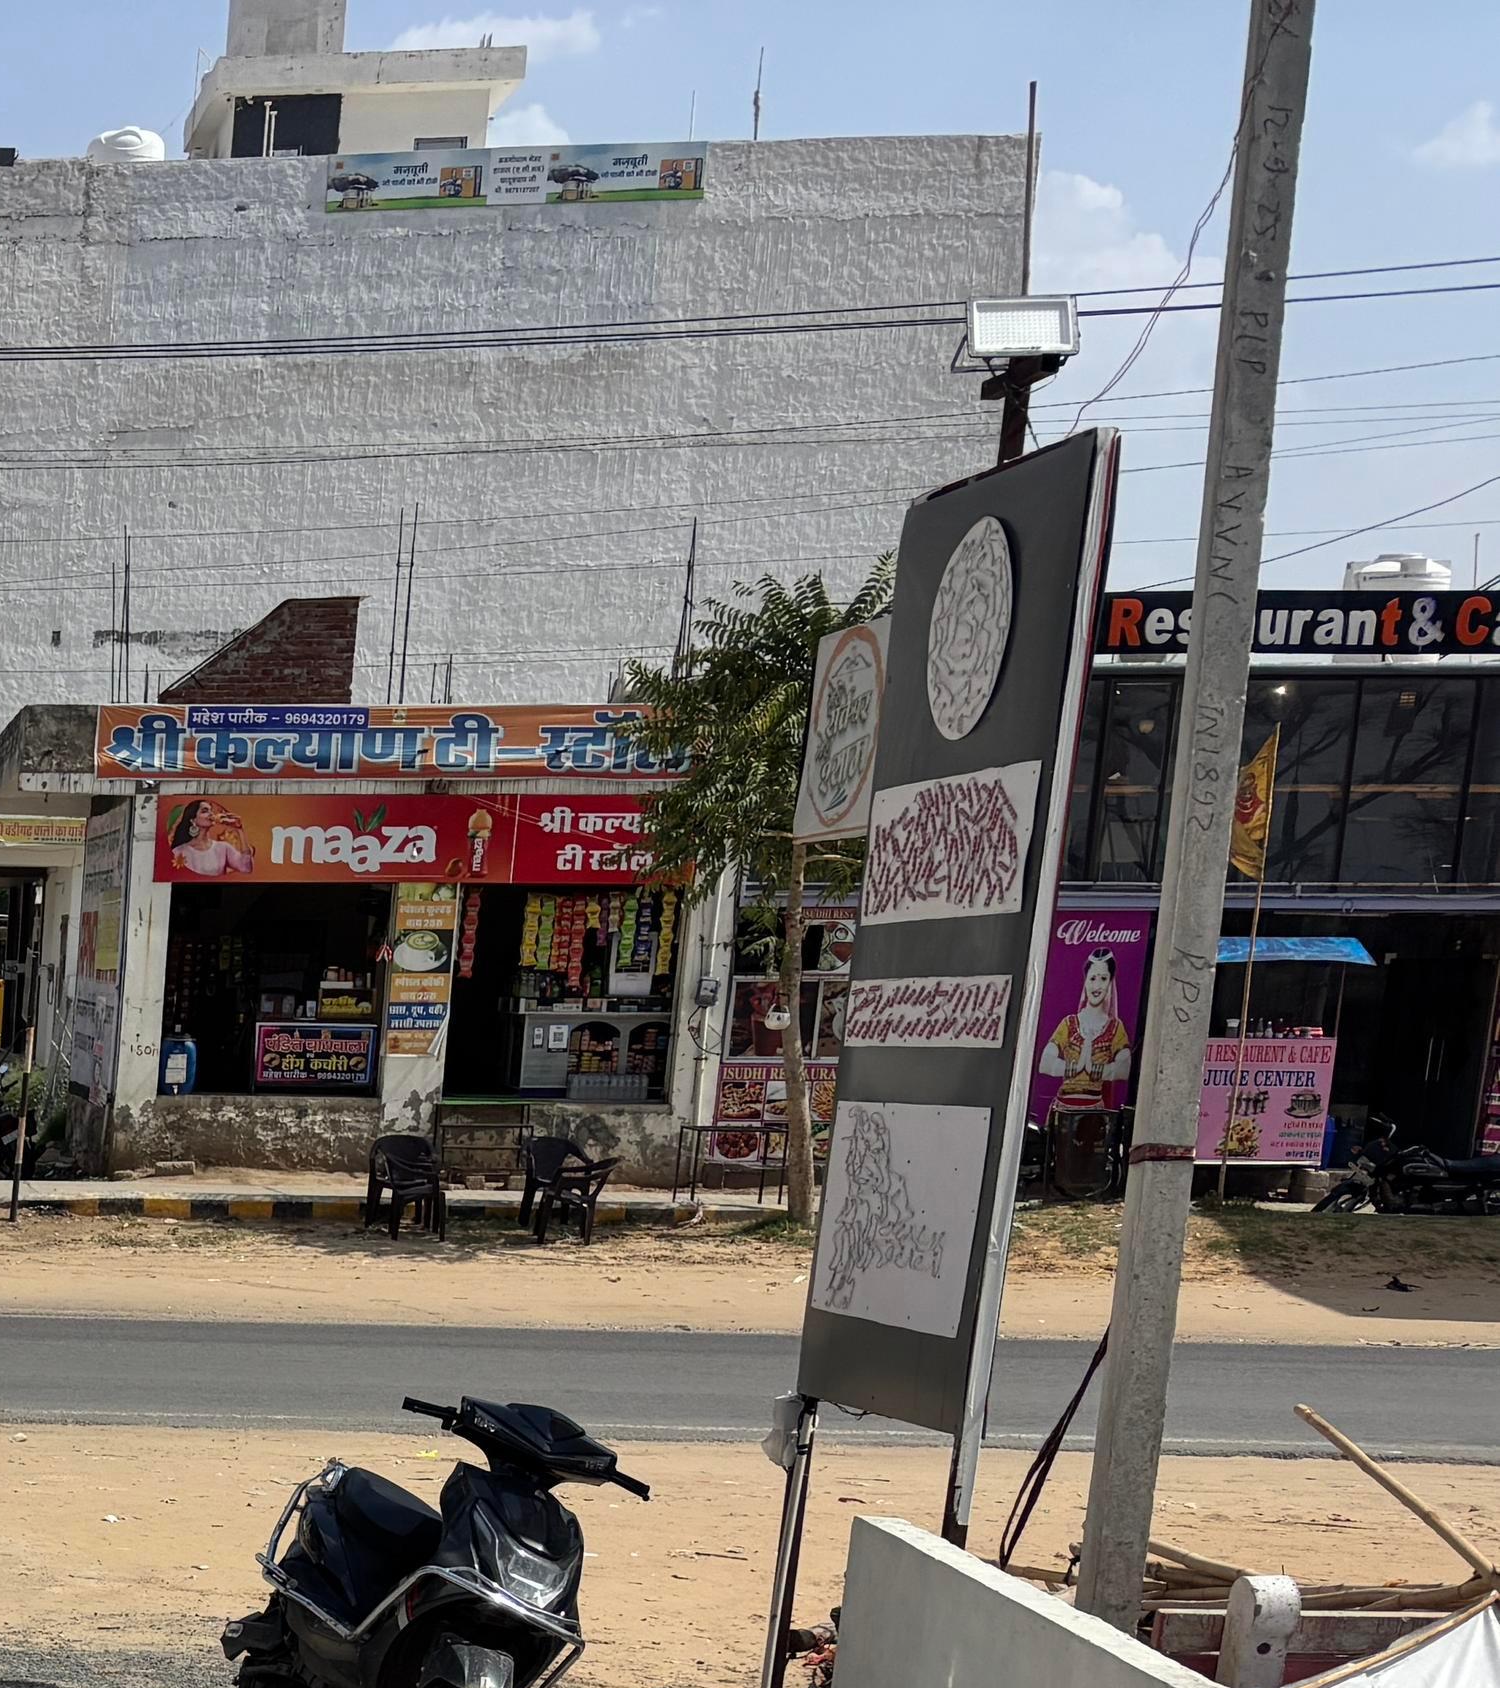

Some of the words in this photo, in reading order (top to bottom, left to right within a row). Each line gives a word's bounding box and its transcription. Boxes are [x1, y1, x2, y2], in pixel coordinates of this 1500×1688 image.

[1107, 597, 1402, 647] Resurant
[1408, 597, 1445, 647] &
[192, 708, 224, 724] महेश
[228, 708, 268, 724] पारीक
[285, 712, 366, 726] 9694320179
[104, 712, 188, 772] श्री
[194, 728, 430, 774] कल्याण
[537, 806, 573, 834] श्री
[270, 822, 437, 873] maaza
[556, 842, 585, 871] टी
[1056, 919, 1142, 945] Welcome
[1215, 1044, 1287, 1063] RESAURENT
[1288, 1045, 1297, 1064] &
[1300, 1045, 1332, 1064] CAFE
[1254, 1069, 1316, 1088] CENTER
